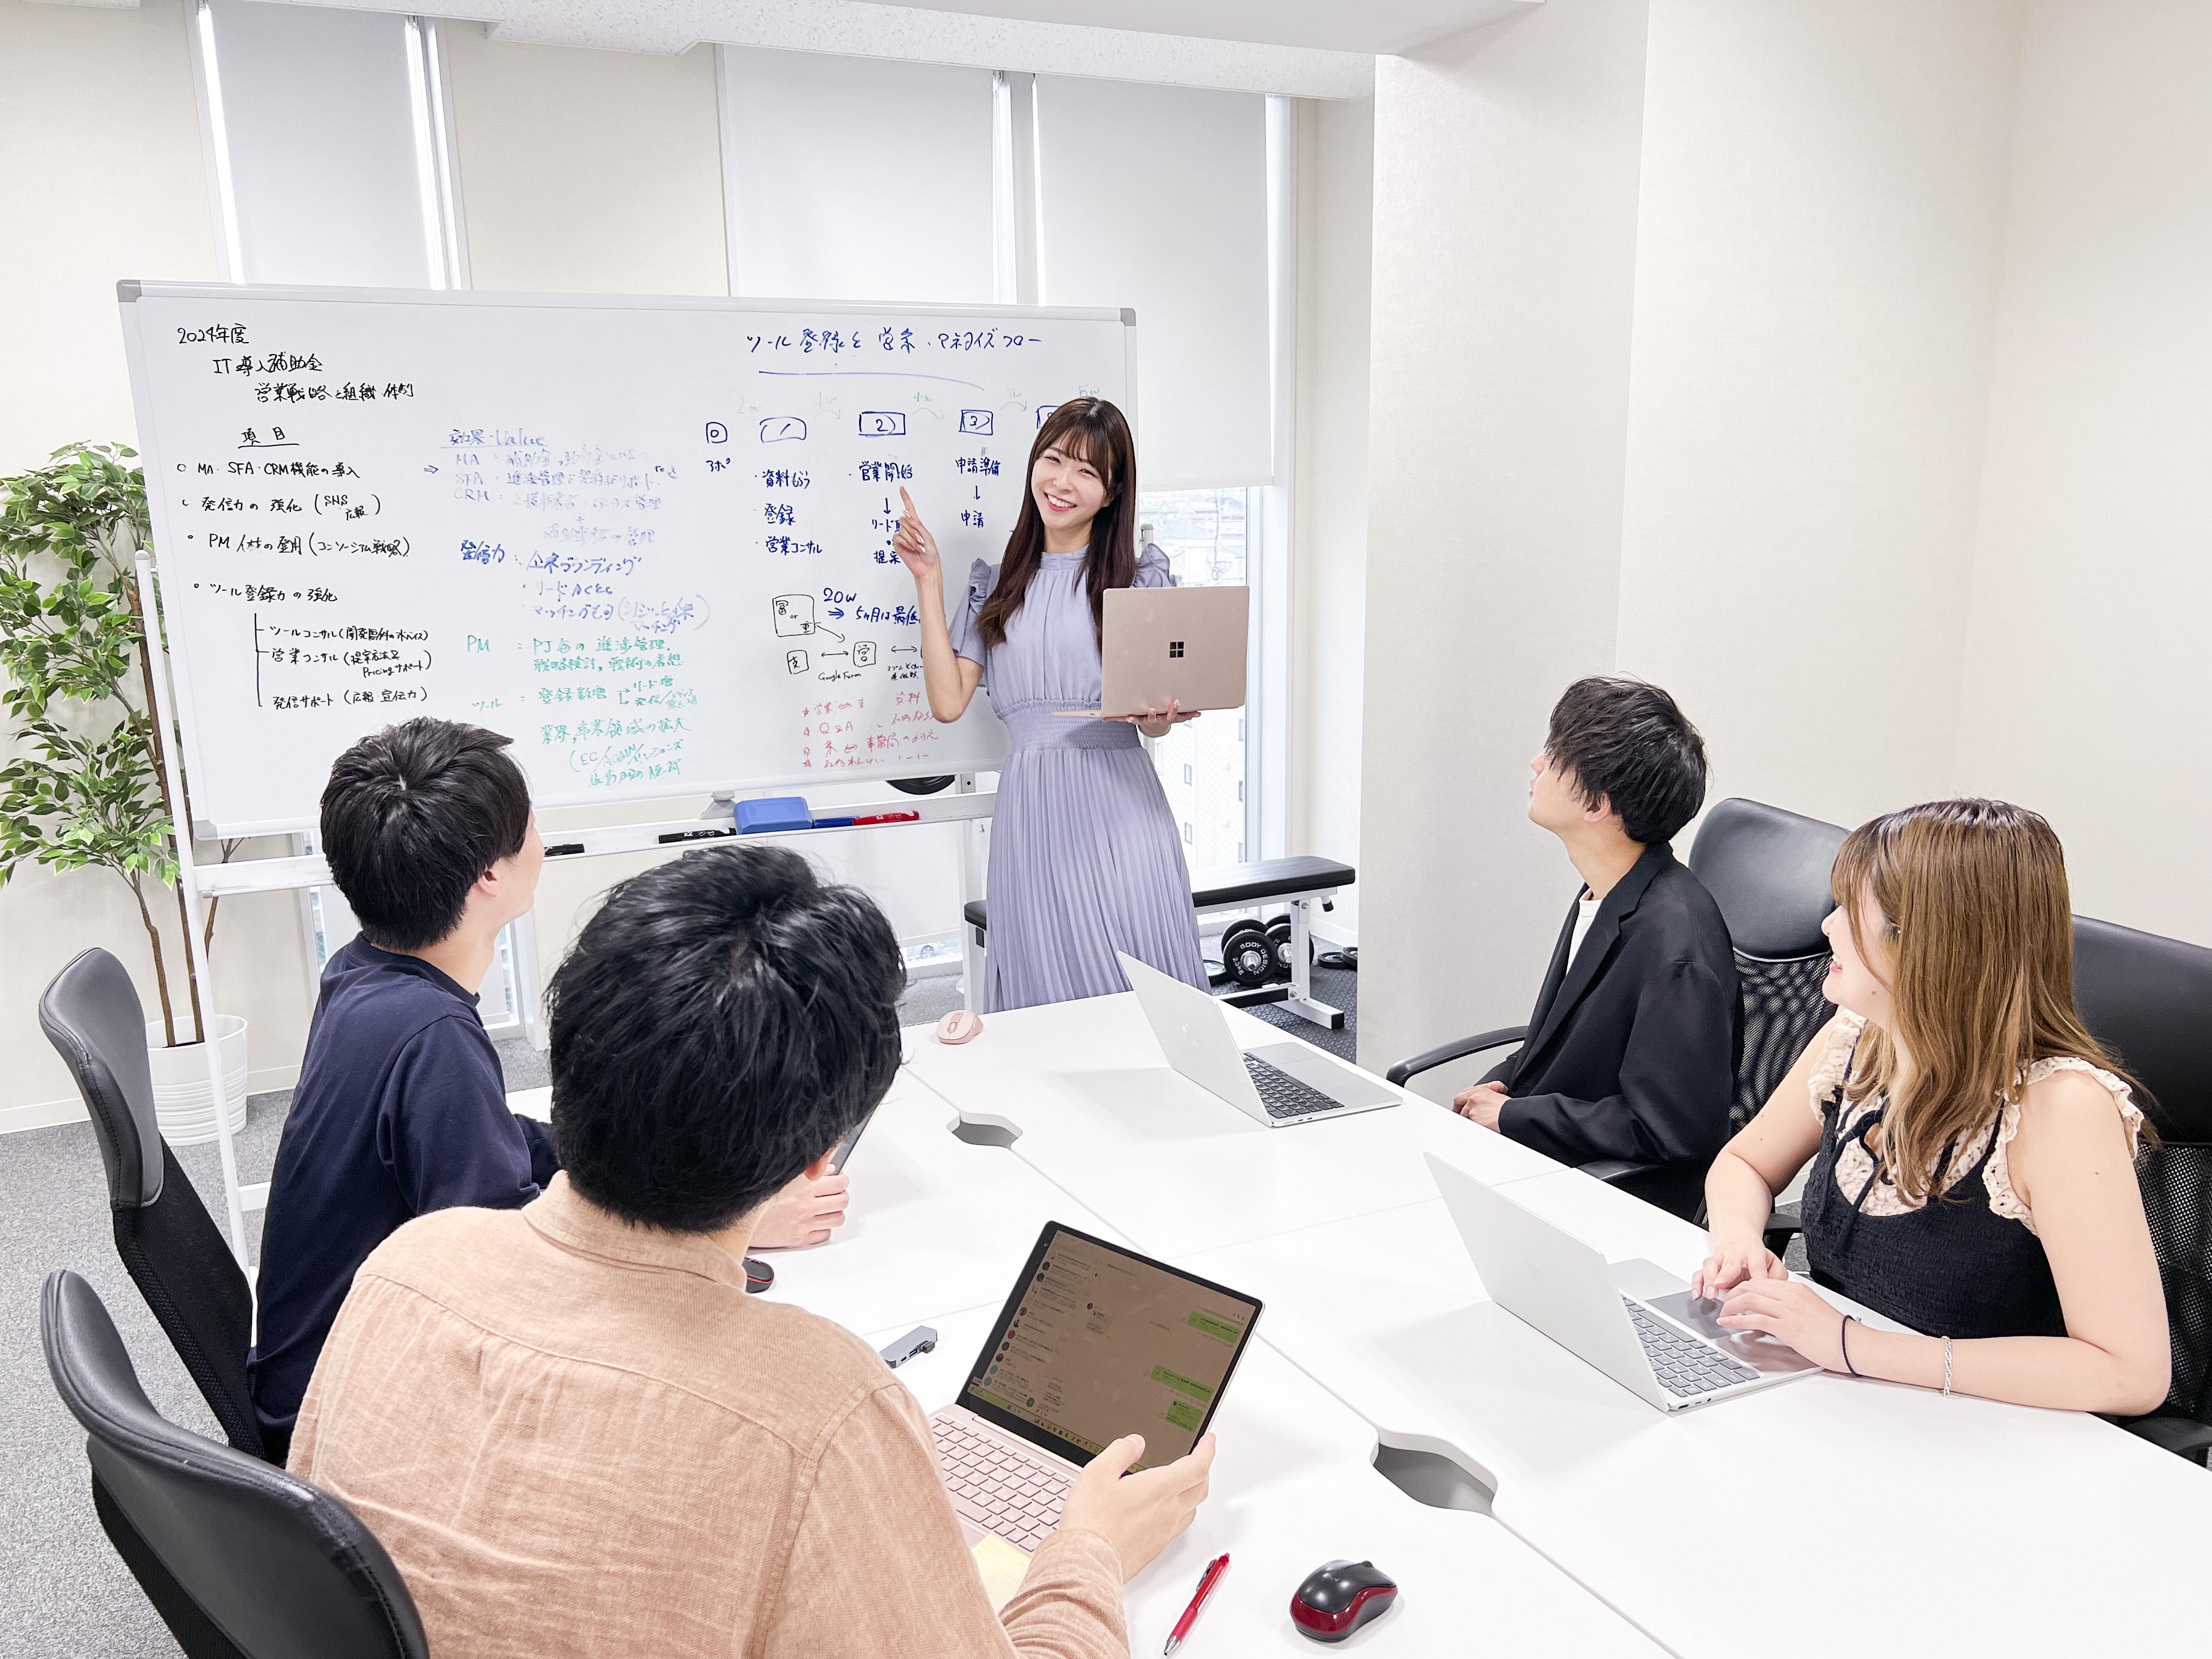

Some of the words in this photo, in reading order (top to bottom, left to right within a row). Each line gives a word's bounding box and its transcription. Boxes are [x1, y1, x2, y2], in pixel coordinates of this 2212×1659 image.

[177, 323, 249, 344] 2024年度
[212, 351, 323, 377] IT導入補助金
[240, 427, 286, 446] 項目
[859, 460, 913, 482] 営業開始
[765, 503, 796, 527] 登録
[961, 510, 985, 528] 申請
[765, 536, 823, 556] 営業コンサル
[1239, 941, 1262, 950] BODY
[1253, 949, 1269, 976] DESIGN
